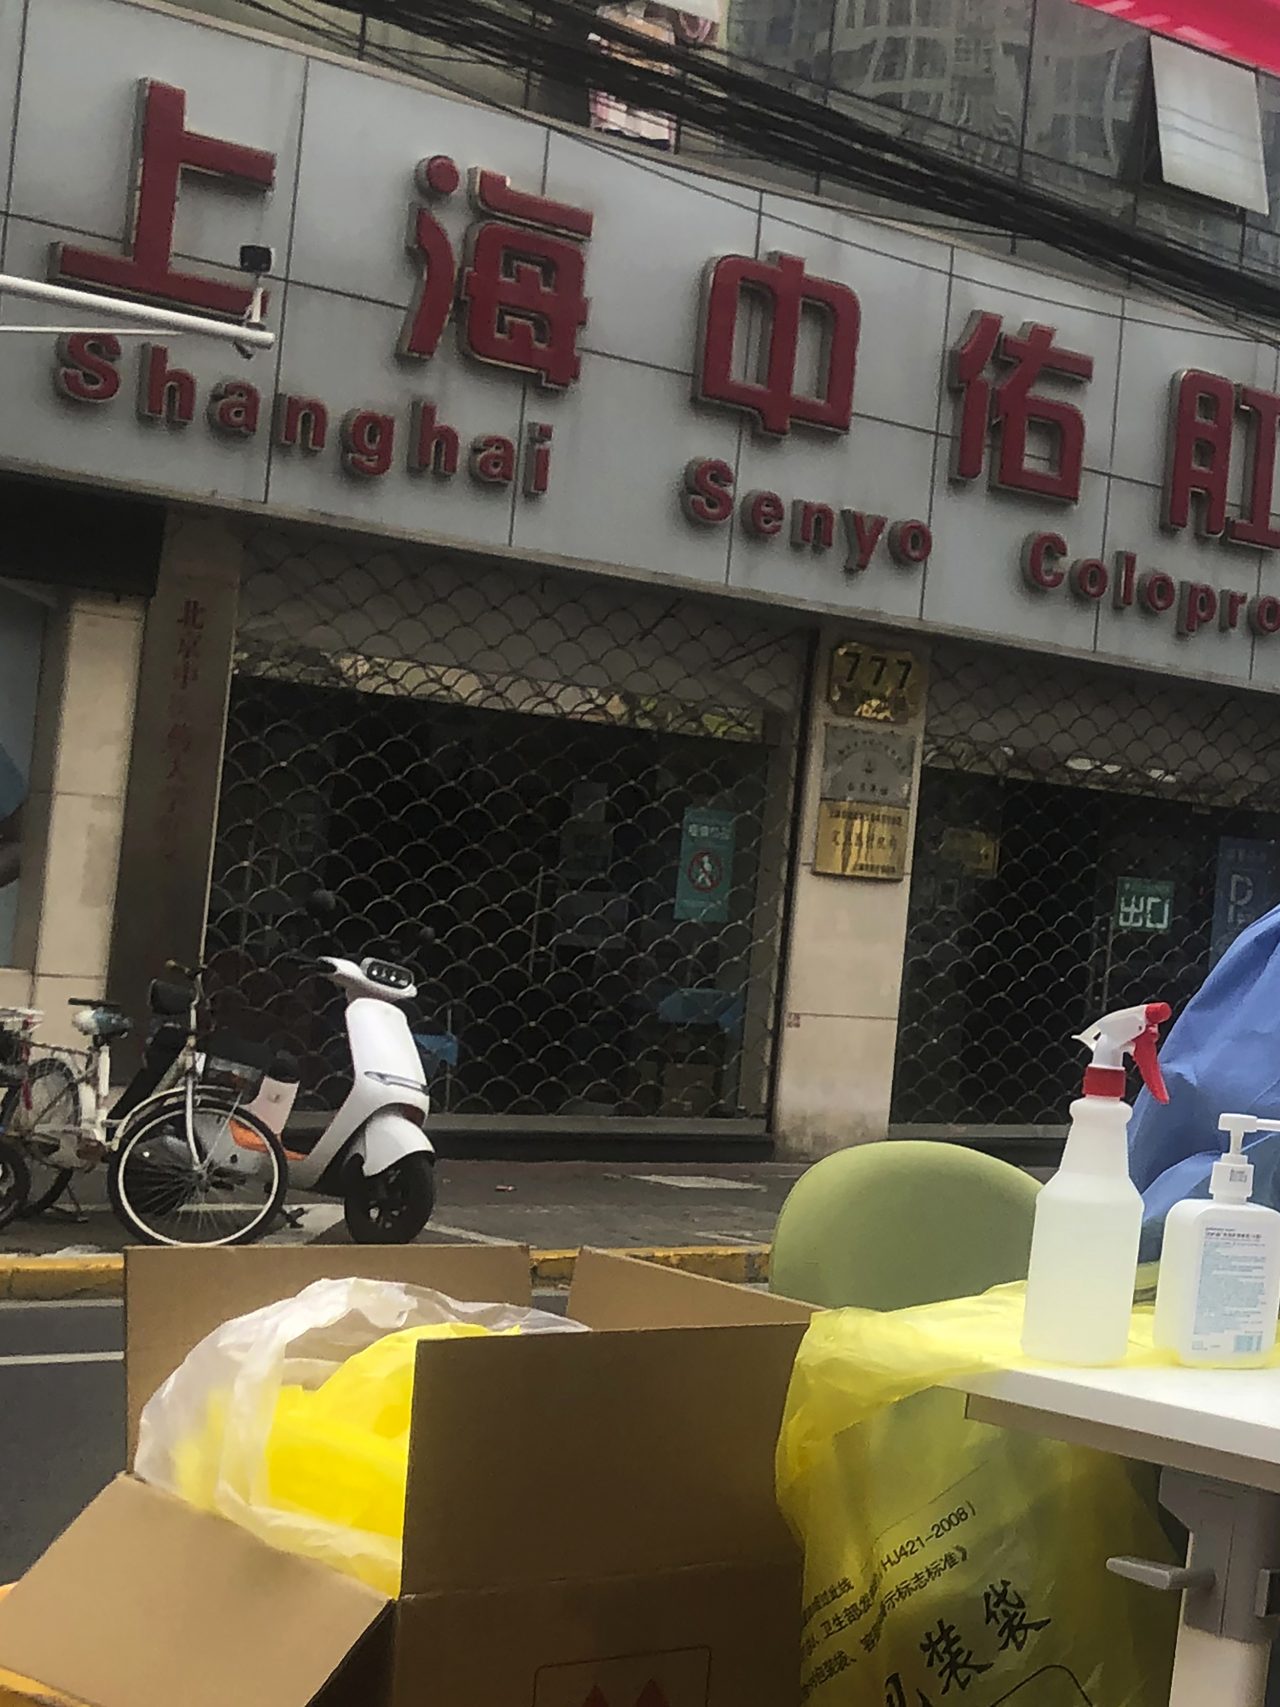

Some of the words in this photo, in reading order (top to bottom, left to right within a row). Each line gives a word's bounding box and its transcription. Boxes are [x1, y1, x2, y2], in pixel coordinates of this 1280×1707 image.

[56, 332, 554, 495] Shanghai
[682, 457, 932, 572] Senyo
[843, 651, 914, 690] 777
[1119, 895, 1170, 929] 出口
